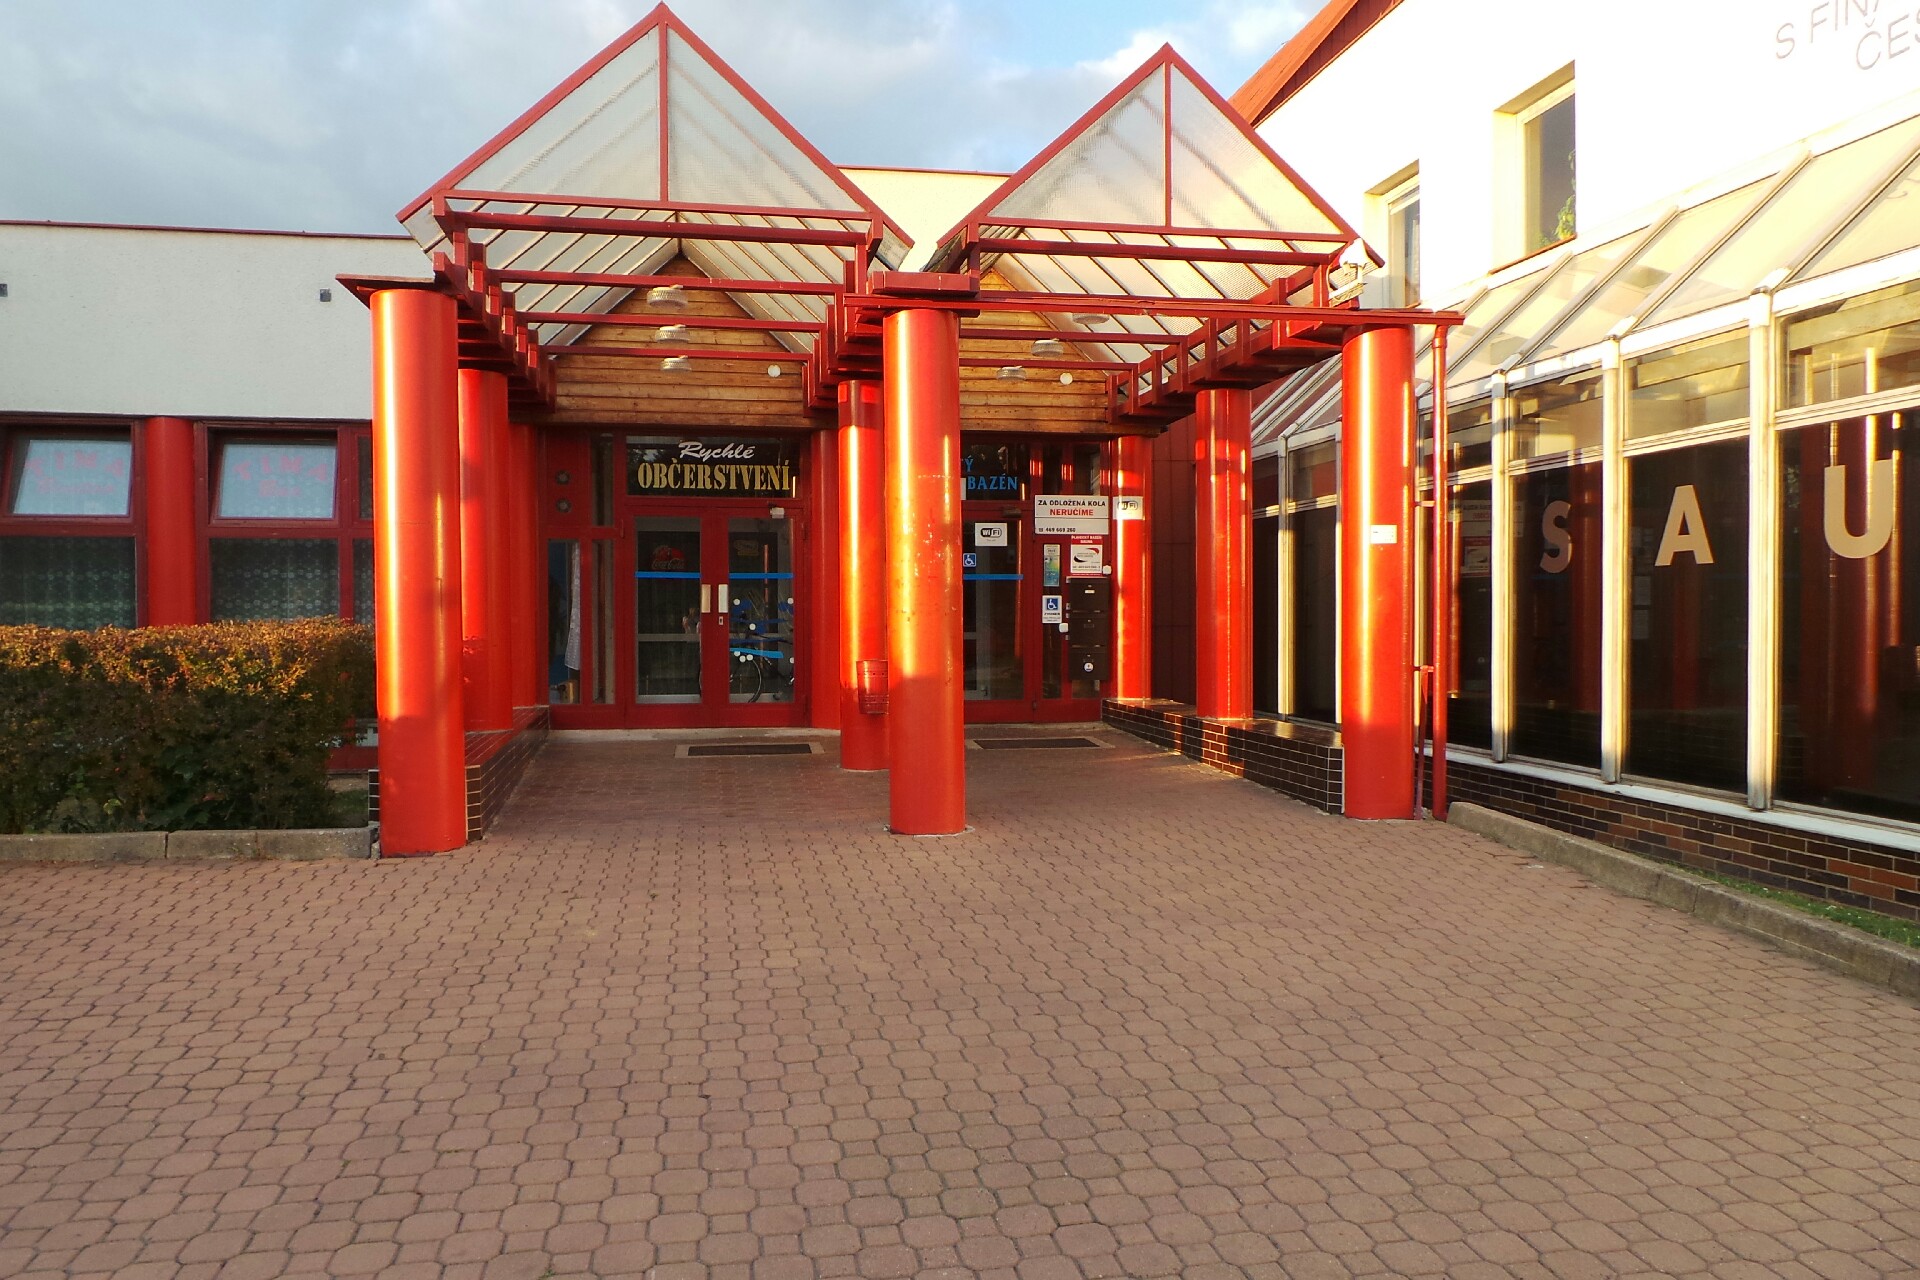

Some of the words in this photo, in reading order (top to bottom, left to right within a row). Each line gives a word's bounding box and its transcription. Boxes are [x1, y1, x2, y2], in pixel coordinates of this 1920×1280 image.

[1776, 22, 1795, 59] S
[1810, 0, 1879, 43] FIN
[678, 441, 756, 462] Rychlé
[638, 458, 790, 490] OBČERSTVENÍ
[967, 473, 1018, 490] BAZÉN
[1049, 499, 1086, 507] ODLOŽENÁ
[1049, 507, 1094, 516] NERUČÍME
